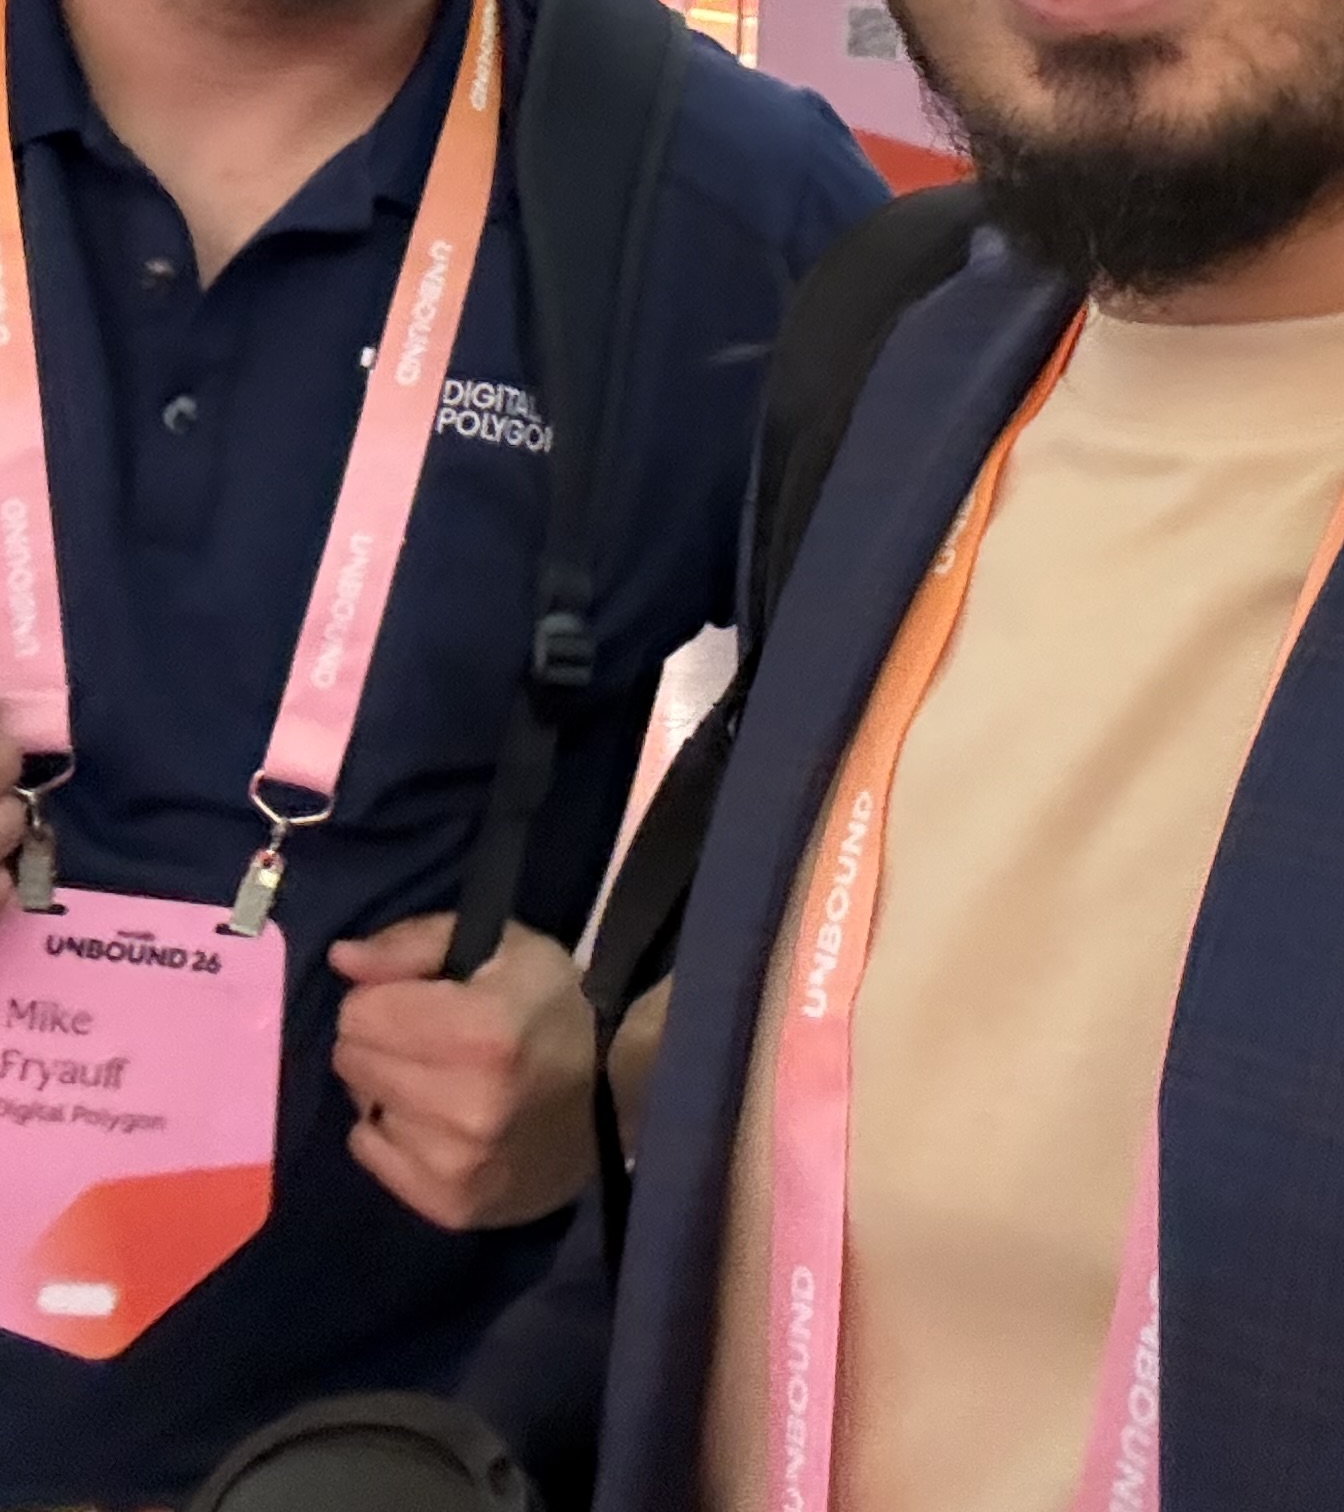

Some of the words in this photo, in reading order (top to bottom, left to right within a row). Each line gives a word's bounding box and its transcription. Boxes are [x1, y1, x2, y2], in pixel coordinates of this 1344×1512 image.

[443, 378, 543, 423] DIGITAL
[802, 791, 873, 1018] UNBOUND
[46, 934, 187, 968] UNBOUND
[191, 950, 222, 974] 26
[6, 998, 93, 1036] Mike
[783, 1265, 815, 1512] UNBOUND
